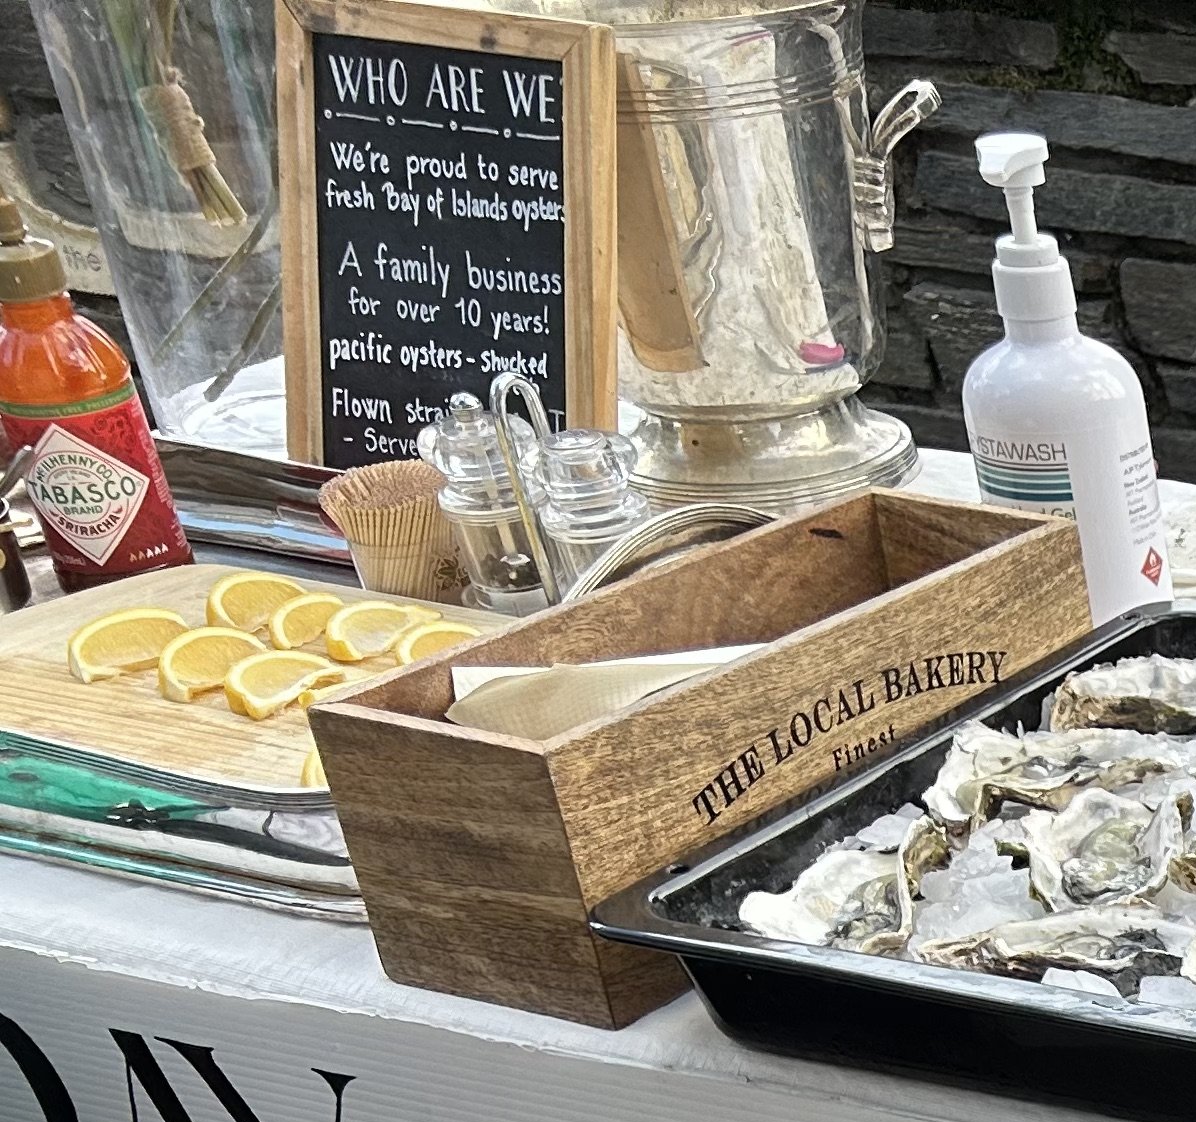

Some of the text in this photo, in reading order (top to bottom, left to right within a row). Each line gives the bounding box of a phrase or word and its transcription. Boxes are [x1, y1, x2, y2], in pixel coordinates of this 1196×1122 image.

[328, 54, 563, 123] WHO ARE WE
[330, 141, 559, 190] We're proud to serve
[325, 178, 375, 210] fresh
[381, 181, 420, 226] Bay
[426, 187, 444, 220] of
[451, 188, 508, 221] Islands
[338, 241, 562, 298] A family business
[348, 286, 550, 340] for over 10 years!
[329, 332, 393, 370] pacific
[399, 339, 462, 372] oysters
[332, 387, 450, 424] Flown strai
[364, 427, 419, 456] Serve
[28, 476, 136, 504] TABASCO
[63, 505, 103, 515] BRAND
[58, 514, 120, 536] SRIRACHA
[692, 651, 1008, 826] THE LOCAL BAKERY
[832, 724, 897, 772] Finest
